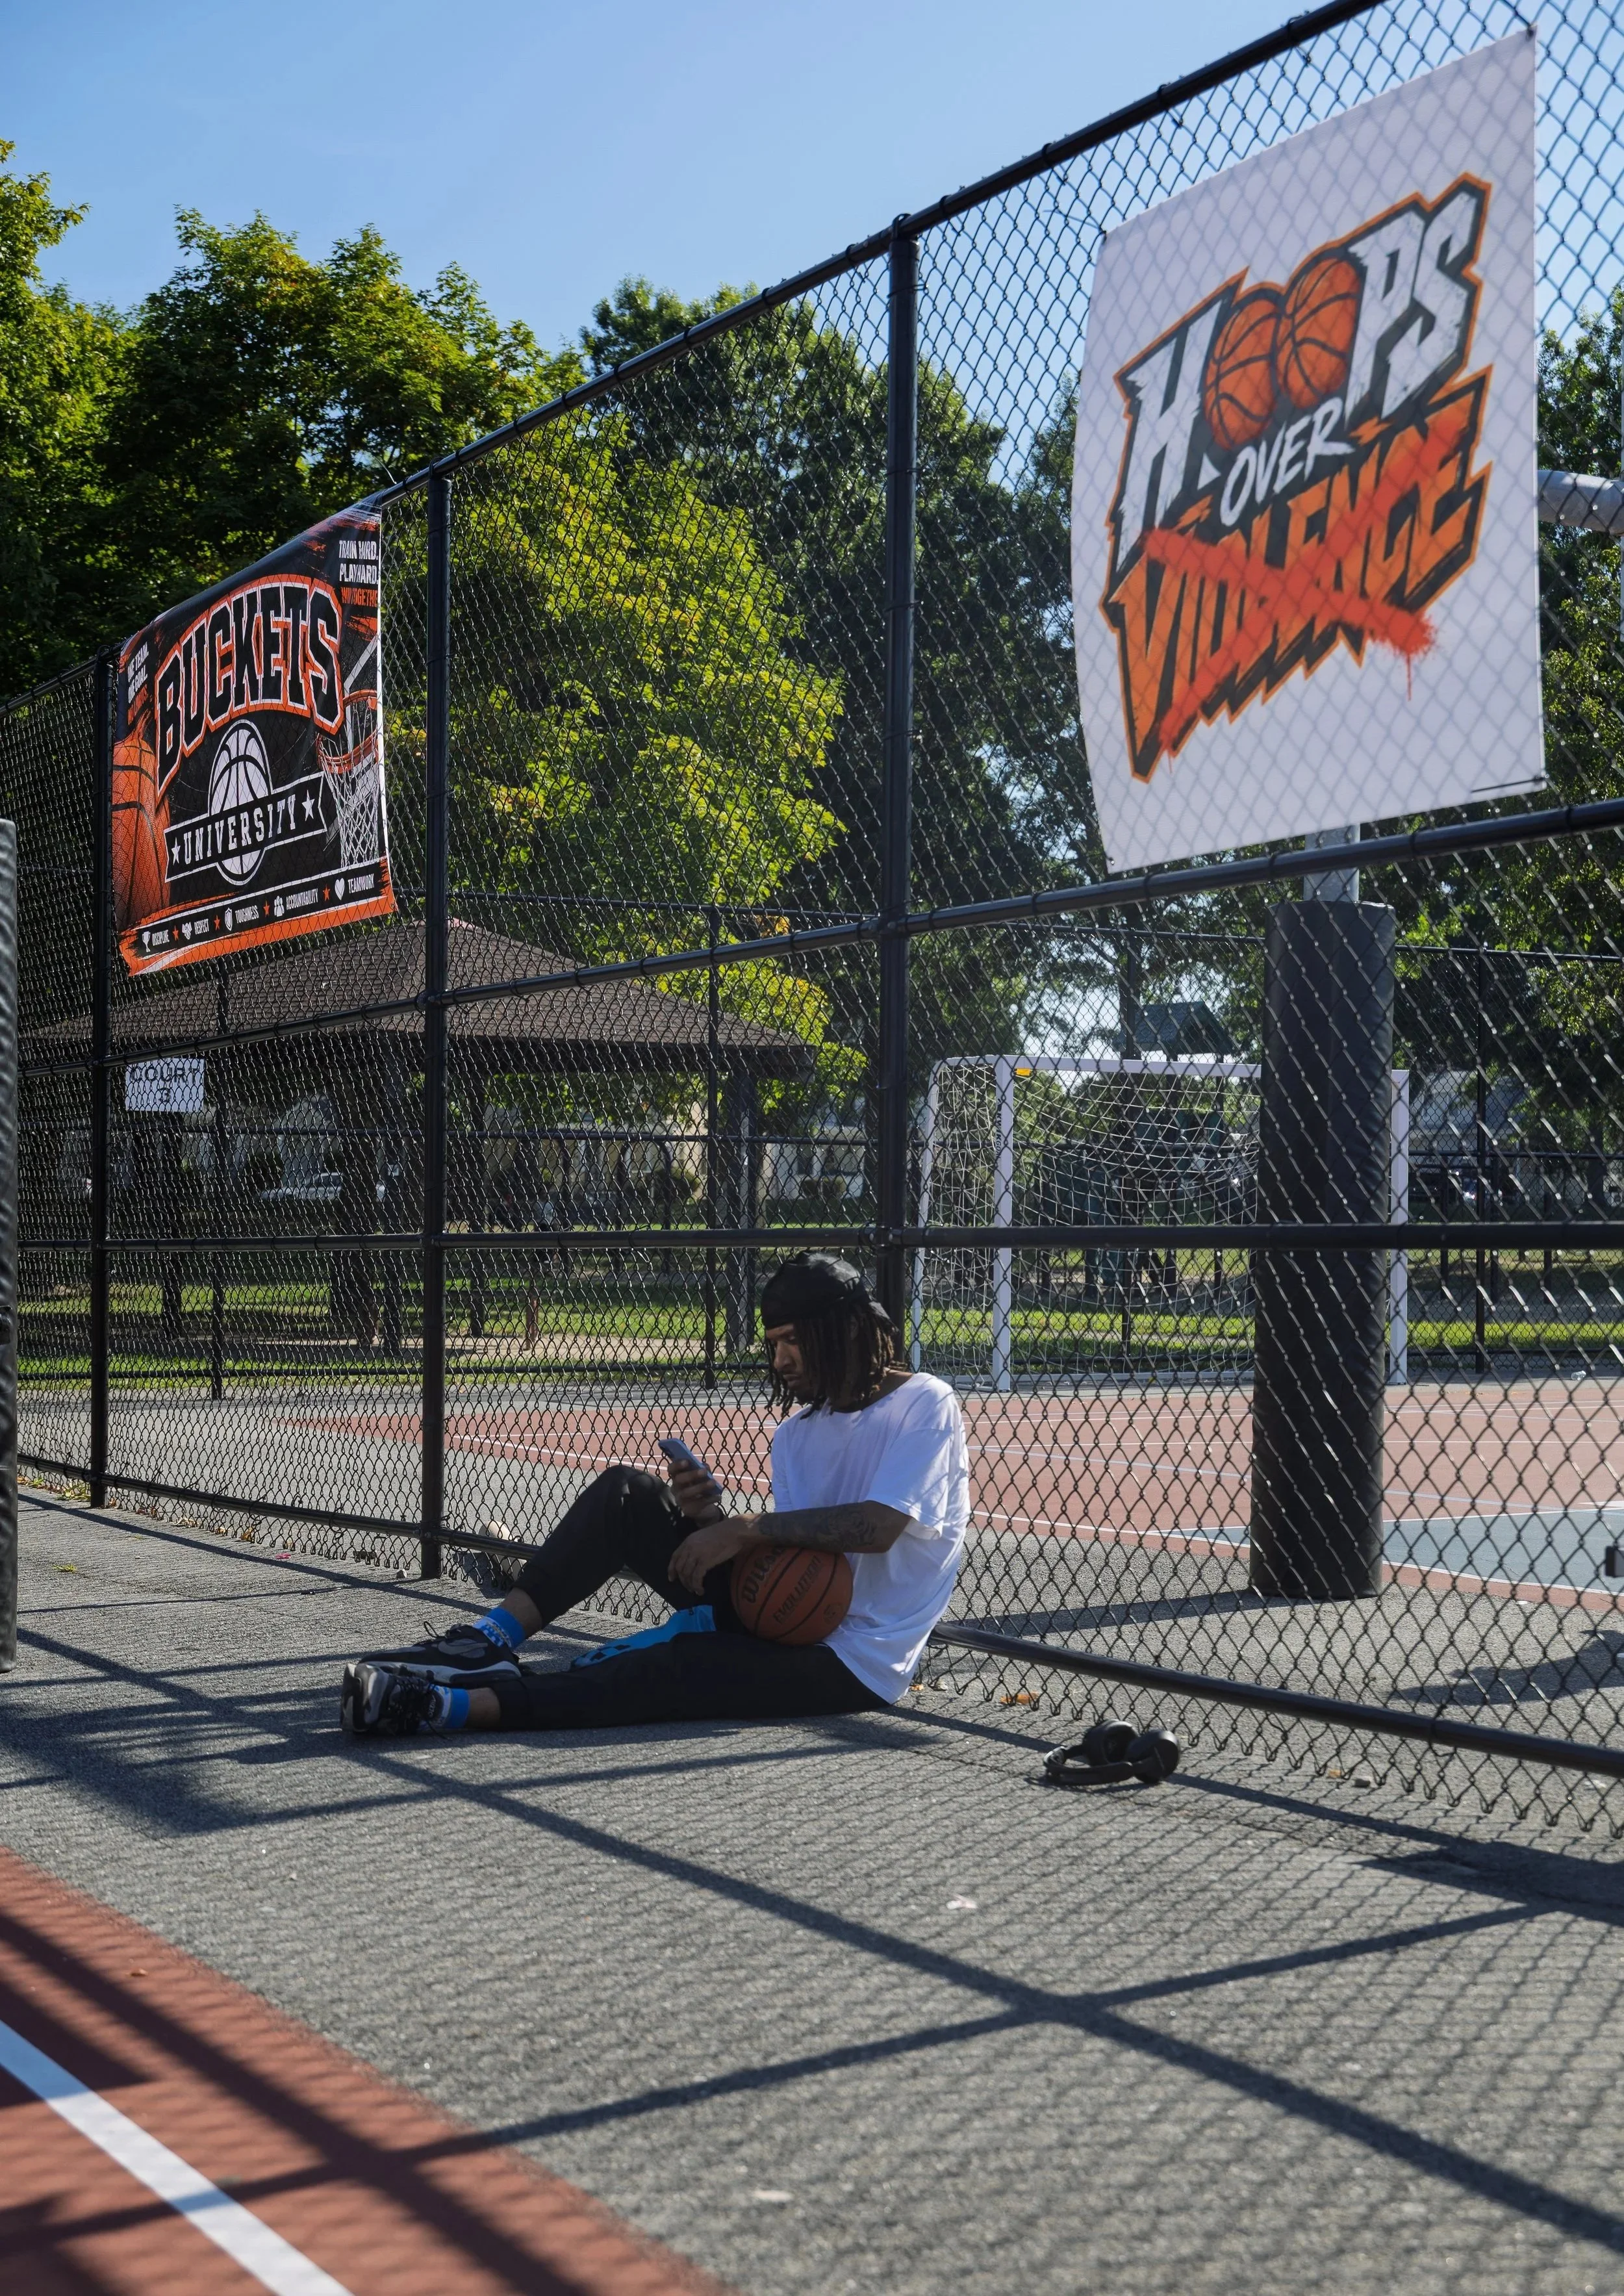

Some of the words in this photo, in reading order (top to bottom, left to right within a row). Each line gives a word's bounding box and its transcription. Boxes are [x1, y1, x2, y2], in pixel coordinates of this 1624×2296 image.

[1220, 396, 1356, 527] OVER
[338, 540, 357, 559] TRAIN
[339, 563, 357, 583] PLAY
[1108, 390, 1473, 757] VIOLENCE
[155, 580, 342, 799] BUCKETS
[183, 793, 296, 865] UNIVERSITY
[194, 918, 209, 935] RESPECT
[235, 904, 259, 924] TOUGHNESS
[286, 888, 318, 910] ACCOUNTABILITY
[348, 873, 375, 894] TEAMWORK
[131, 1066, 199, 1083] COURT
[159, 1088, 171, 1103] 3
